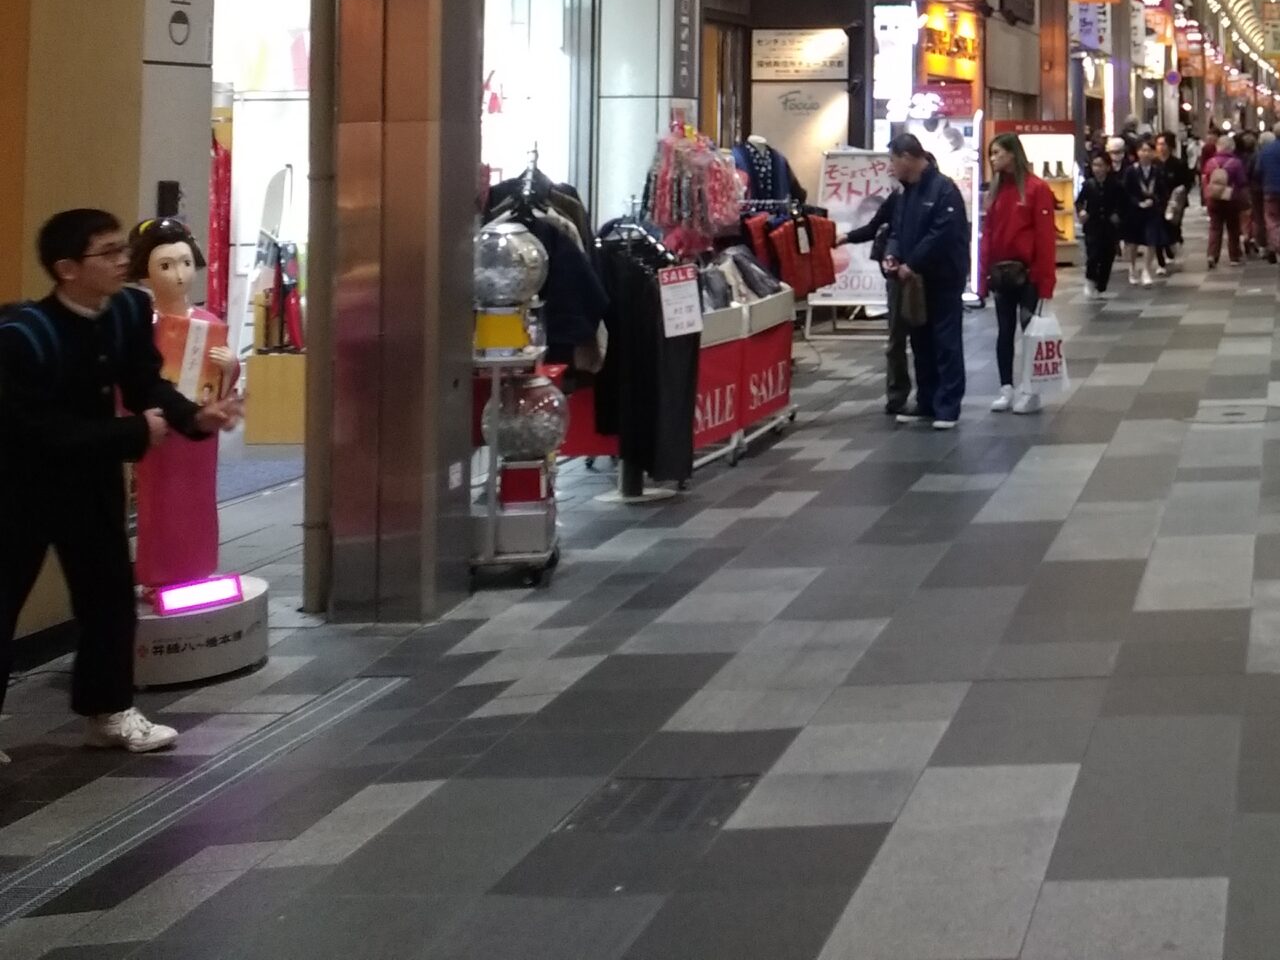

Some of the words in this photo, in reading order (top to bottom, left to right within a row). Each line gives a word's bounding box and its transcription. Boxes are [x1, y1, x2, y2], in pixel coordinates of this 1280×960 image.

[1015, 124, 1056, 133] REGAL
[661, 267, 696, 283] SALE
[750, 360, 787, 410] SALE
